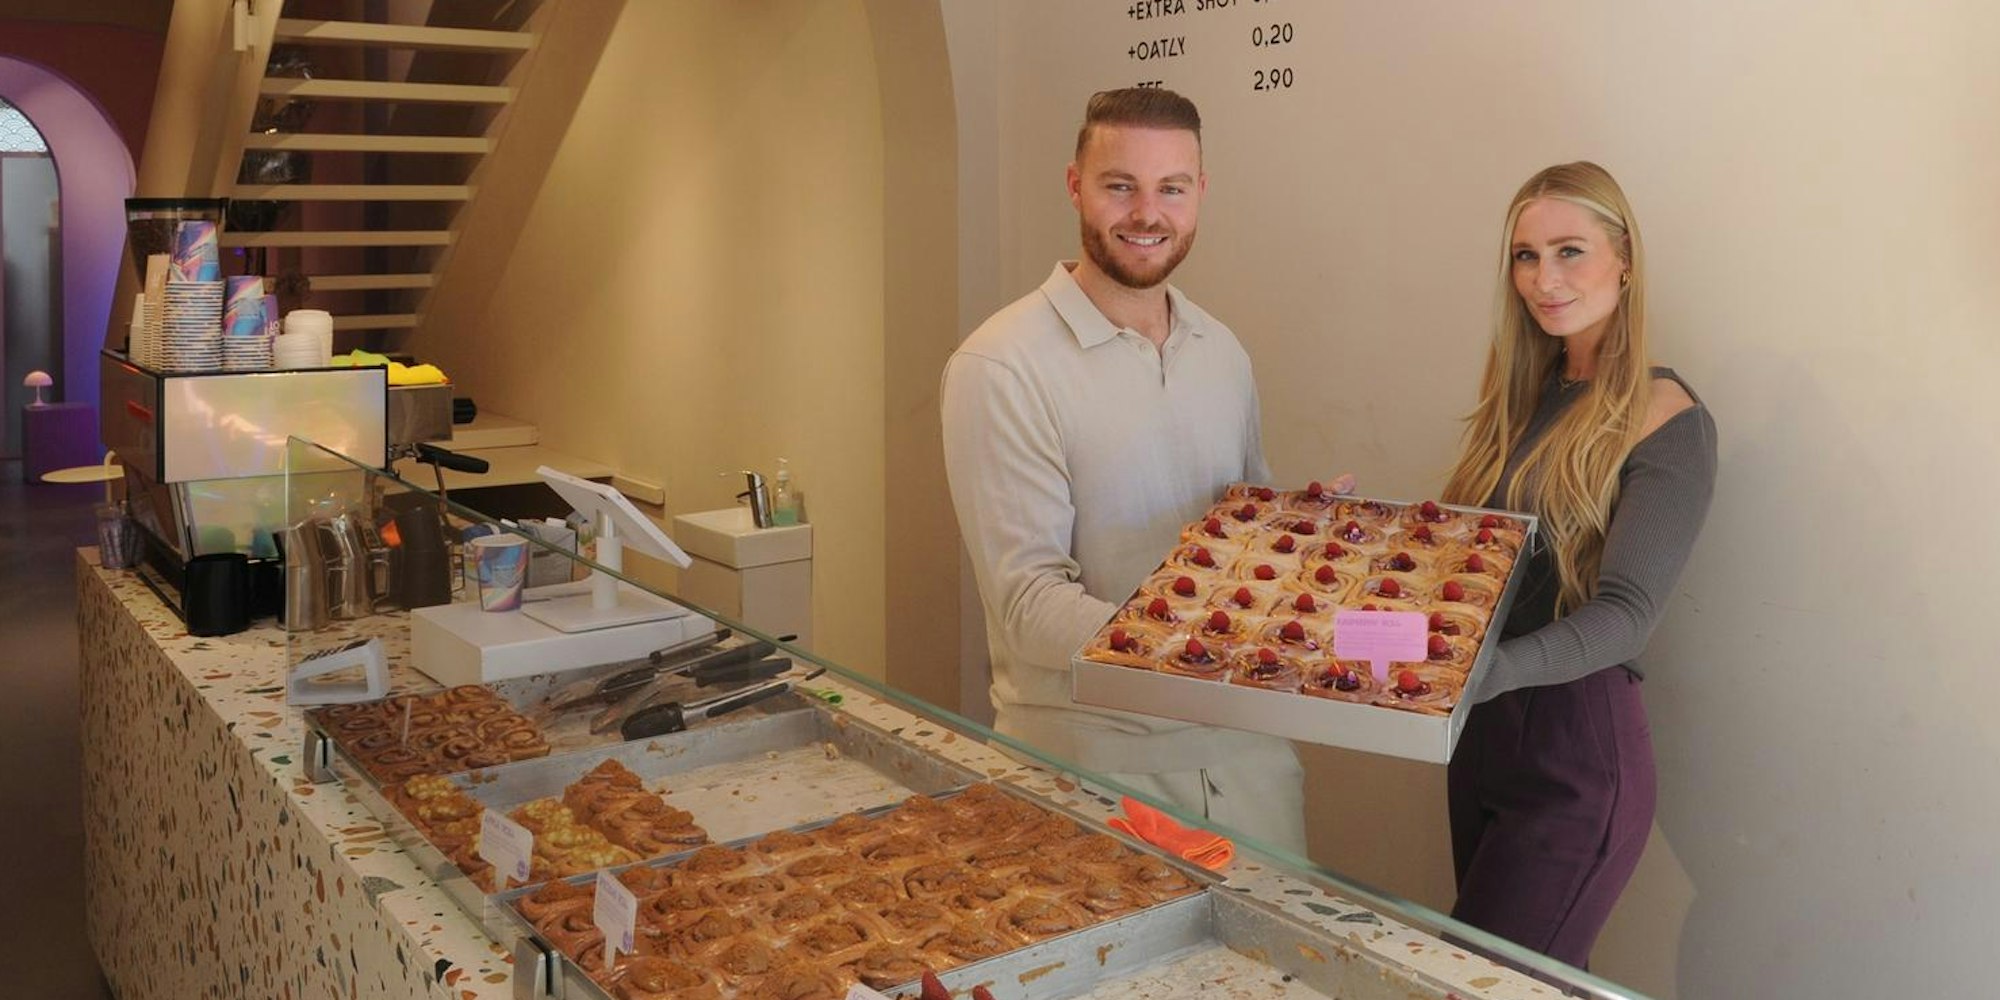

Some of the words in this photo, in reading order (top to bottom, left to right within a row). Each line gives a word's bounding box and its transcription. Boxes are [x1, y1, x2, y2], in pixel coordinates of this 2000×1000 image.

[1128, 0, 1185, 20] +EXTRA
[1128, 36, 1185, 61] +OATLY
[1252, 23, 1293, 47] 0,20
[1254, 68, 1293, 91] 2,90
